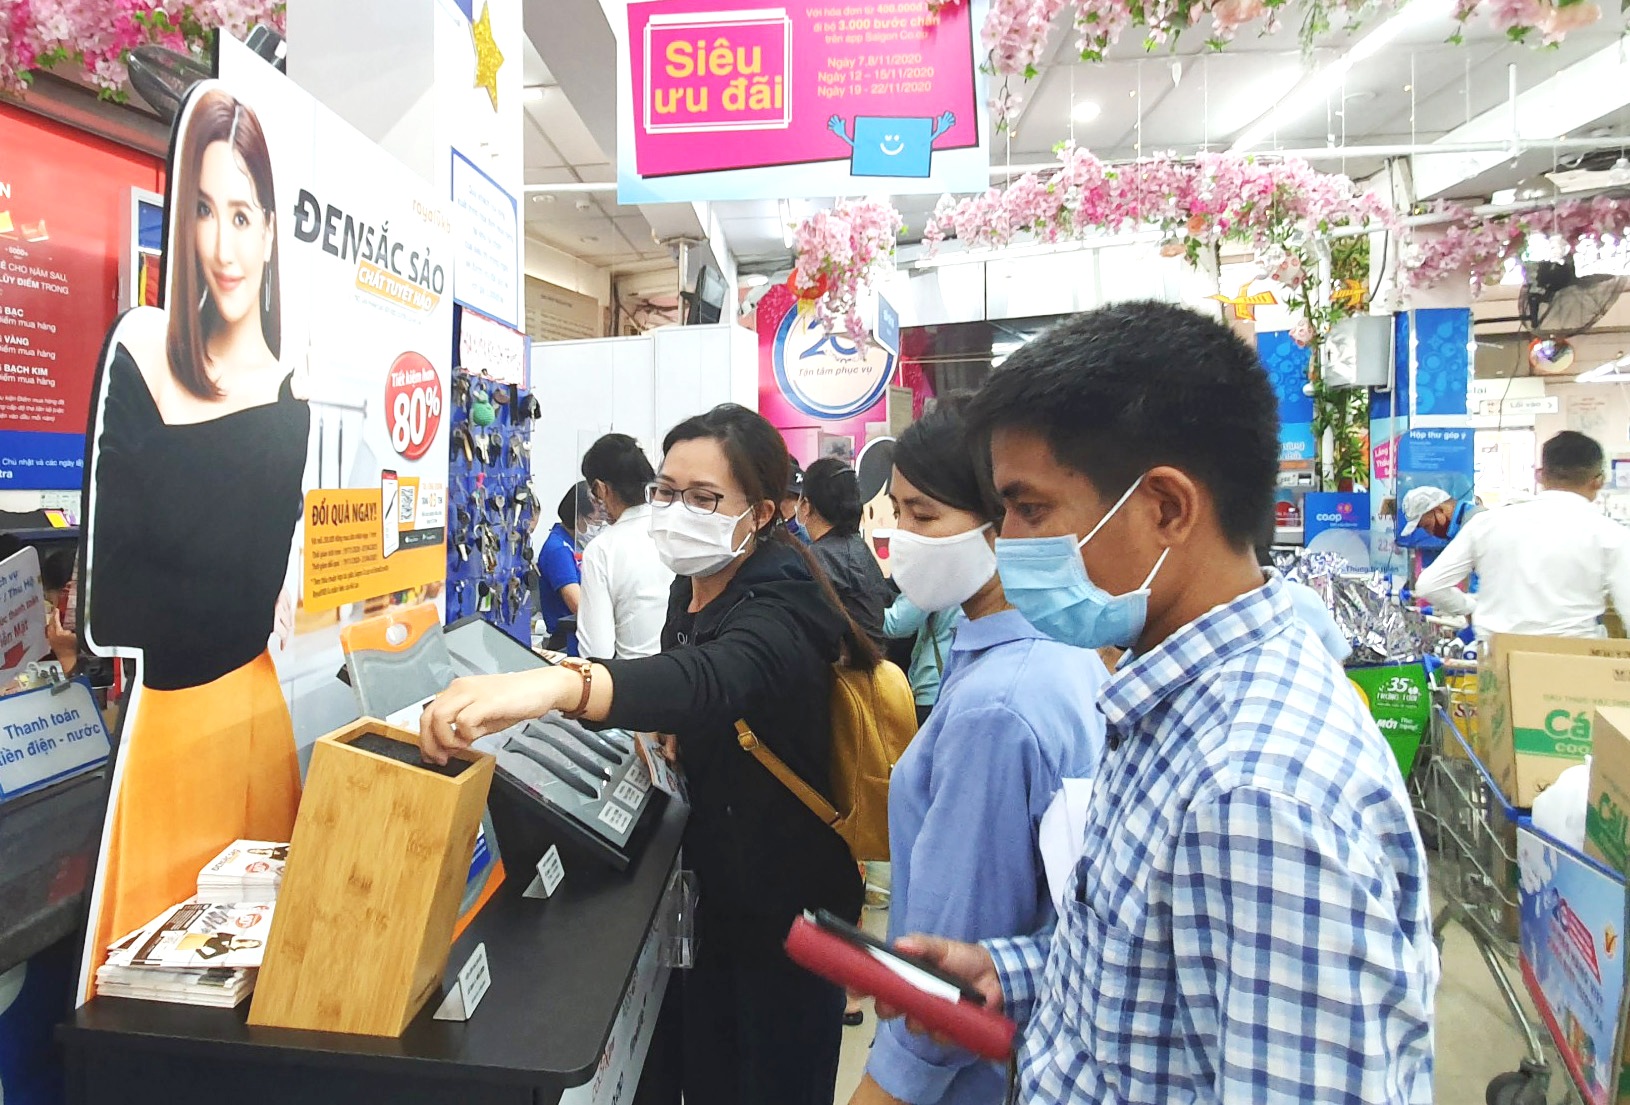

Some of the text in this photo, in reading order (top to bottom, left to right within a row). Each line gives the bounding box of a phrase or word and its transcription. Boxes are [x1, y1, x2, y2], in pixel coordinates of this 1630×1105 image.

[838, 19, 870, 30] 3.000
[873, 17, 907, 29] bước
[665, 37, 761, 78] Siêu
[827, 56, 856, 70] Ngày
[817, 70, 846, 84] Ngày
[849, 70, 862, 81] 12
[655, 75, 782, 114] ưu đãi
[817, 85, 845, 98] Ngày
[871, 81, 932, 94] 22/11/2020
[8, 262, 28, 273] CHO
[408, 247, 444, 295] SẢO
[40, 282, 69, 295] TRONG
[4, 306, 24, 318] BẠC
[18, 319, 36, 329] mua
[37, 321, 56, 333] hàng
[4, 333, 30, 346] VÀNG
[17, 347, 35, 357] mua
[36, 349, 56, 361] hàng
[3, 364, 48, 376] BẠCH KIM
[861, 366, 873, 375] vụ
[17, 376, 35, 385] mua
[36, 375, 56, 388] hàng
[392, 385, 440, 453] 80%
[1410, 430, 1426, 440] Hộp
[1428, 430, 1442, 439] thư
[2, 458, 17, 466] Chủ
[19, 458, 34, 467] nhật
[45, 458, 57, 466] các
[59, 460, 75, 468] ngày
[331, 499, 350, 527] QUÀ
[352, 502, 377, 523] NGAY!
[8, 586, 23, 599] Thu
[1387, 677, 1410, 692] 35
[3, 708, 80, 740] Thanh toán
[27, 738, 57, 755] điện
[66, 723, 101, 743] nước
